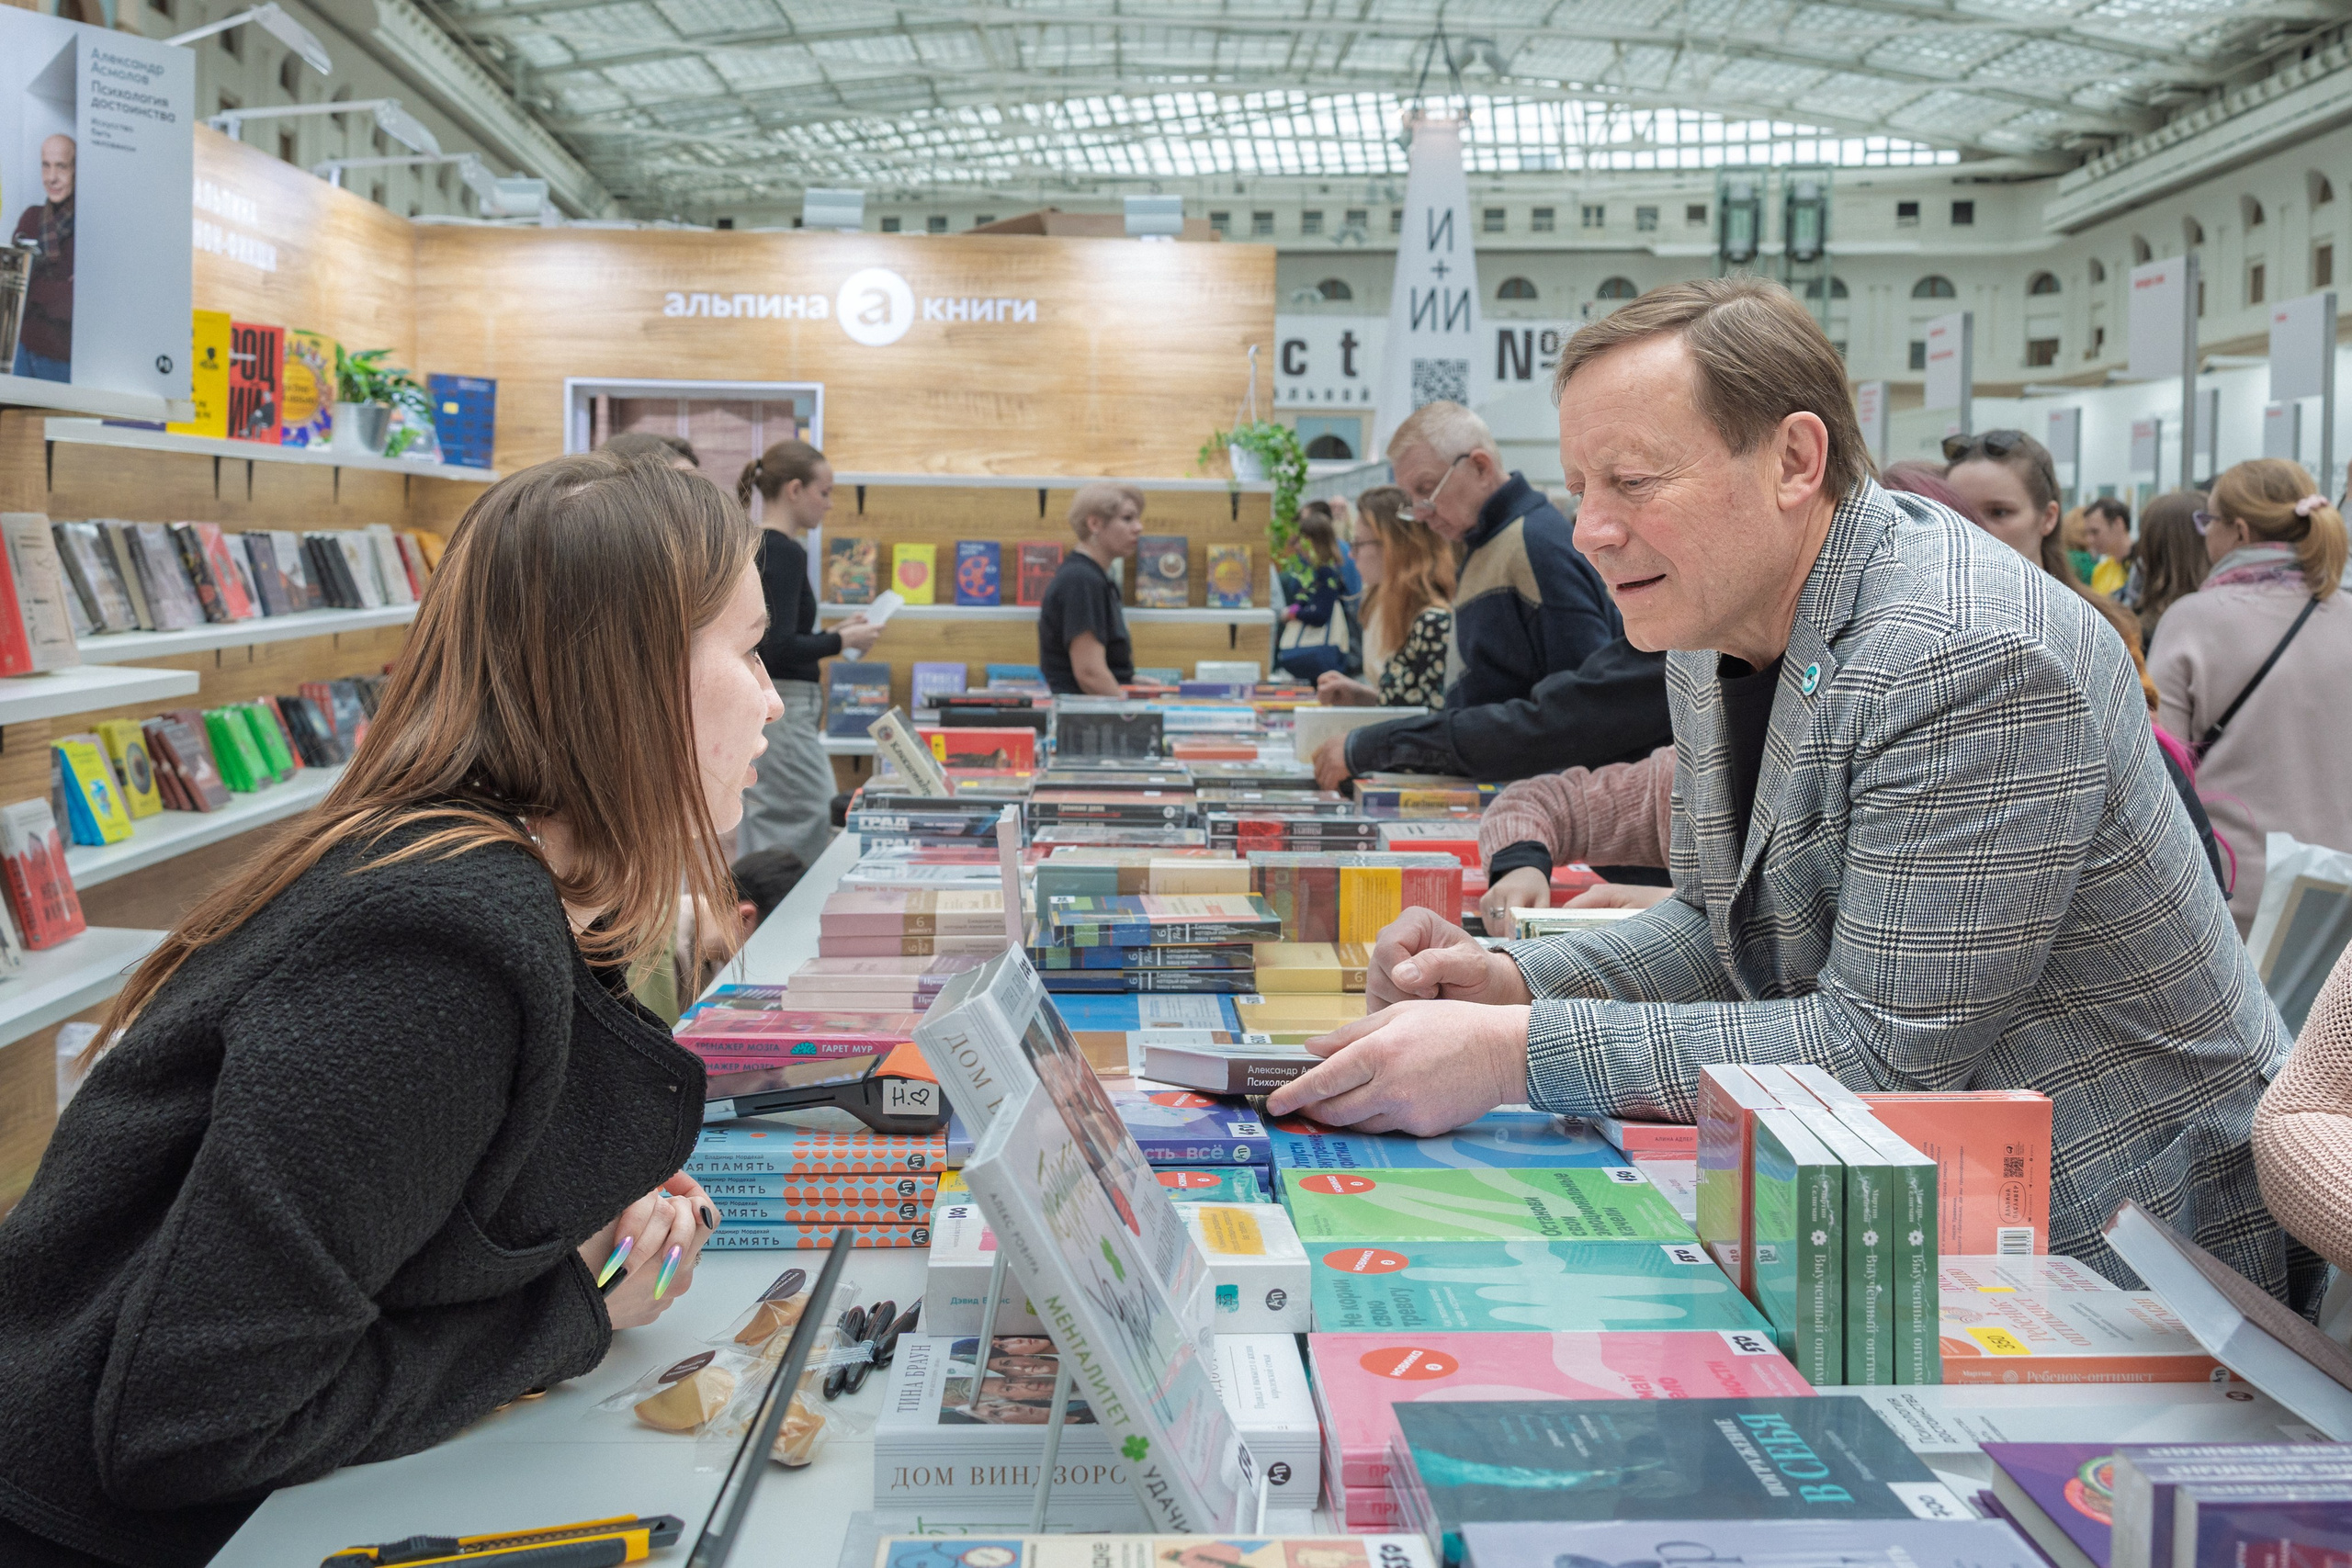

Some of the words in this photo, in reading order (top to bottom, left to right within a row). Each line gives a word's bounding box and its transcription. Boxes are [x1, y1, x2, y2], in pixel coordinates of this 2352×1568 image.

[91, 48, 164, 77] Александр
[91, 62, 149, 85] Асмолов
[92, 79, 169, 107] Психология
[91, 96, 176, 123] достоинства
[1428, 207, 1453, 253] И
[663, 292, 831, 320] альпина
[922, 297, 1038, 323] книги
[1410, 288, 1470, 332] ИИ
[858, 816, 910, 832] ГРАД
[916, 917, 924, 928] 6
[1354, 971, 1363, 983] 6
[696, 1043, 744, 1051] ТРЕНАЖЕР
[747, 1043, 780, 1052] МОЗГА
[852, 1045, 874, 1054] МУР
[942, 1032, 993, 1090] ДОМ
[1248, 1065, 1298, 1076] Александр
[1238, 1123, 1260, 1135] 450
[710, 1162, 775, 1172] ПАМЯТЬ
[1615, 1170, 1638, 1182] 450
[704, 1185, 766, 1194] ПАМЯТЬ
[1523, 1196, 1563, 1236] Останови
[1554, 1172, 1612, 1236] эмоциональные
[1871, 1189, 1880, 1219] Мартин
[1561, 1215, 1588, 1236] свои
[1602, 1207, 1638, 1236] качели
[717, 1237, 780, 1246] ПАМЯТЬ
[1674, 1249, 1700, 1262] 550
[950, 1296, 979, 1306] Дэвид
[982, 1296, 1011, 1305] Бнс
[1332, 1279, 1363, 1311] корми
[1388, 1287, 1428, 1327] тревогу
[1815, 1254, 1830, 1333] Выученный
[1866, 1254, 1881, 1333] Выученный
[1911, 1254, 1927, 1333] Выученный
[1339, 1313, 1367, 1327] Не
[1367, 1300, 1394, 1327] свою
[1732, 1336, 1767, 1353] 550
[1986, 1335, 2016, 1349] 350
[904, 1344, 932, 1378] БРАУН
[1045, 1295, 1131, 1429] МЕНТАЛИТЕТ
[2026, 1370, 2154, 1383] Ребенок-оптимист
[897, 1382, 923, 1413] ТИНА
[1713, 1417, 1791, 1497] ПОГРУЖЕНИЕ
[1736, 1412, 1830, 1480] СЕБЯ
[891, 1466, 954, 1490] ДОМ
[1143, 1465, 1193, 1535] УДАЧИ
[1798, 1483, 1856, 1504] В
